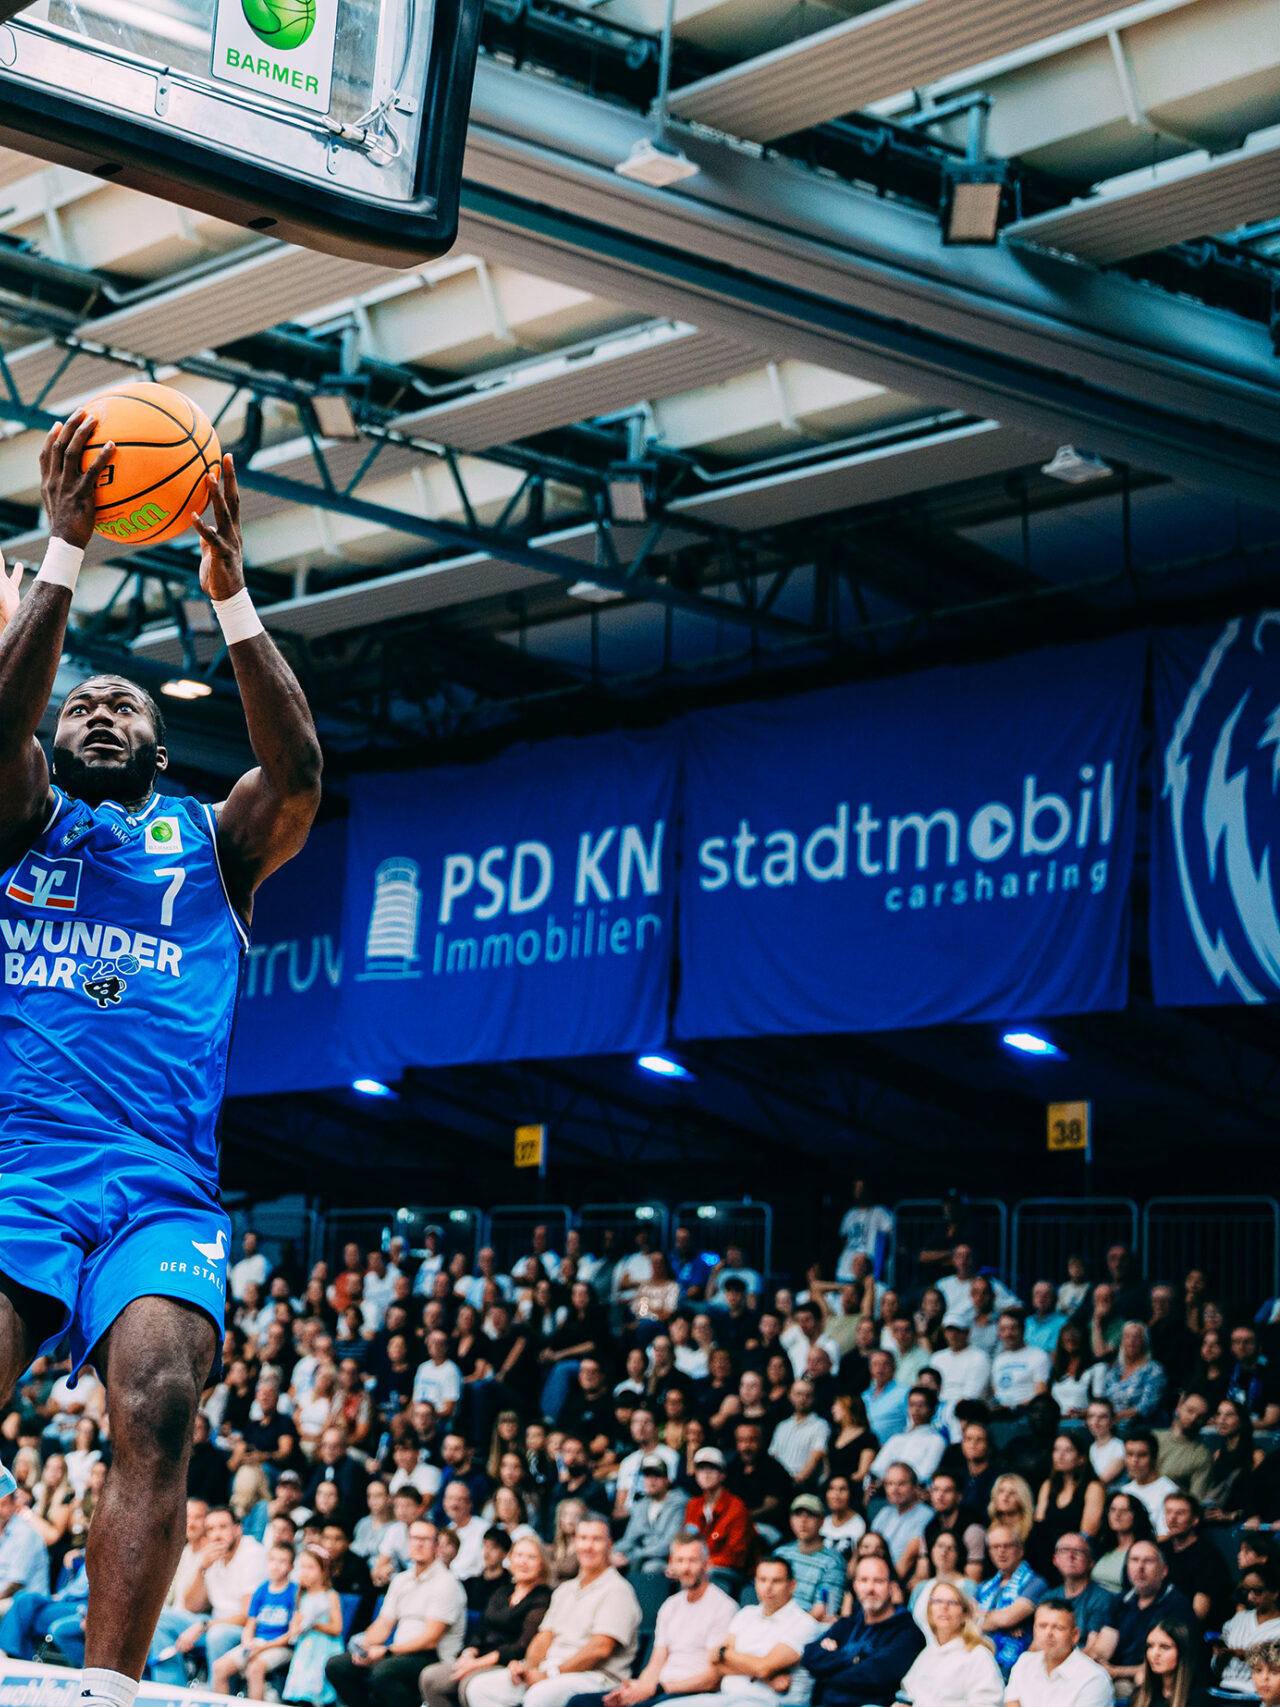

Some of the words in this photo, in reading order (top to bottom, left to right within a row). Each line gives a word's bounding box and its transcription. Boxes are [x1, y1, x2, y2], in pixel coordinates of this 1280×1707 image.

[225, 47, 320, 95] BARMER
[698, 760, 1114, 891] stadtmobil
[154, 867, 187, 927] 7
[437, 839, 554, 925] PSD
[573, 818, 666, 906] KN
[884, 857, 1109, 912] carsharing
[432, 907, 663, 976] Immobilien
[5, 952, 77, 990] BAR
[160, 1261, 188, 1273] DER
